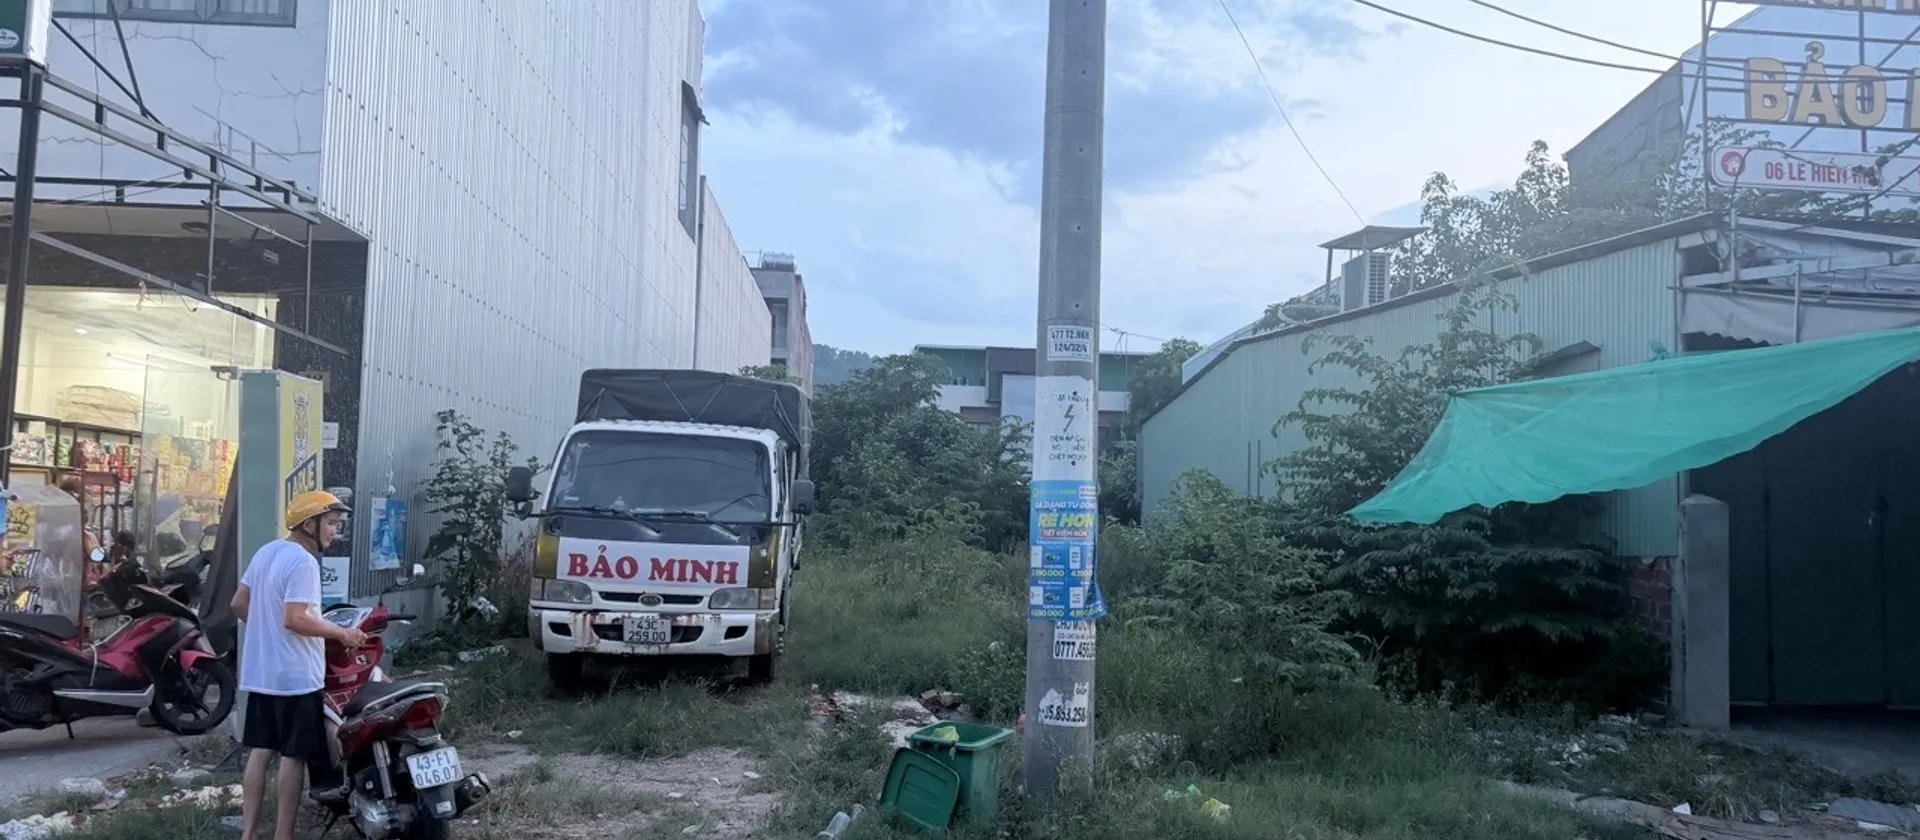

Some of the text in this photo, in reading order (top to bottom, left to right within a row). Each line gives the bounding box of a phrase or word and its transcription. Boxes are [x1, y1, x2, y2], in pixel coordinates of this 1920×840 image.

[1745, 41, 1887, 127] BẢO
[1765, 161, 1784, 180] 06
[567, 545, 738, 584] BẢO MINH
[636, 619, 659, 630] 43C
[628, 630, 667, 641] 259.00
[415, 751, 450, 771] 43-F1
[415, 765, 459, 786] 046.07
